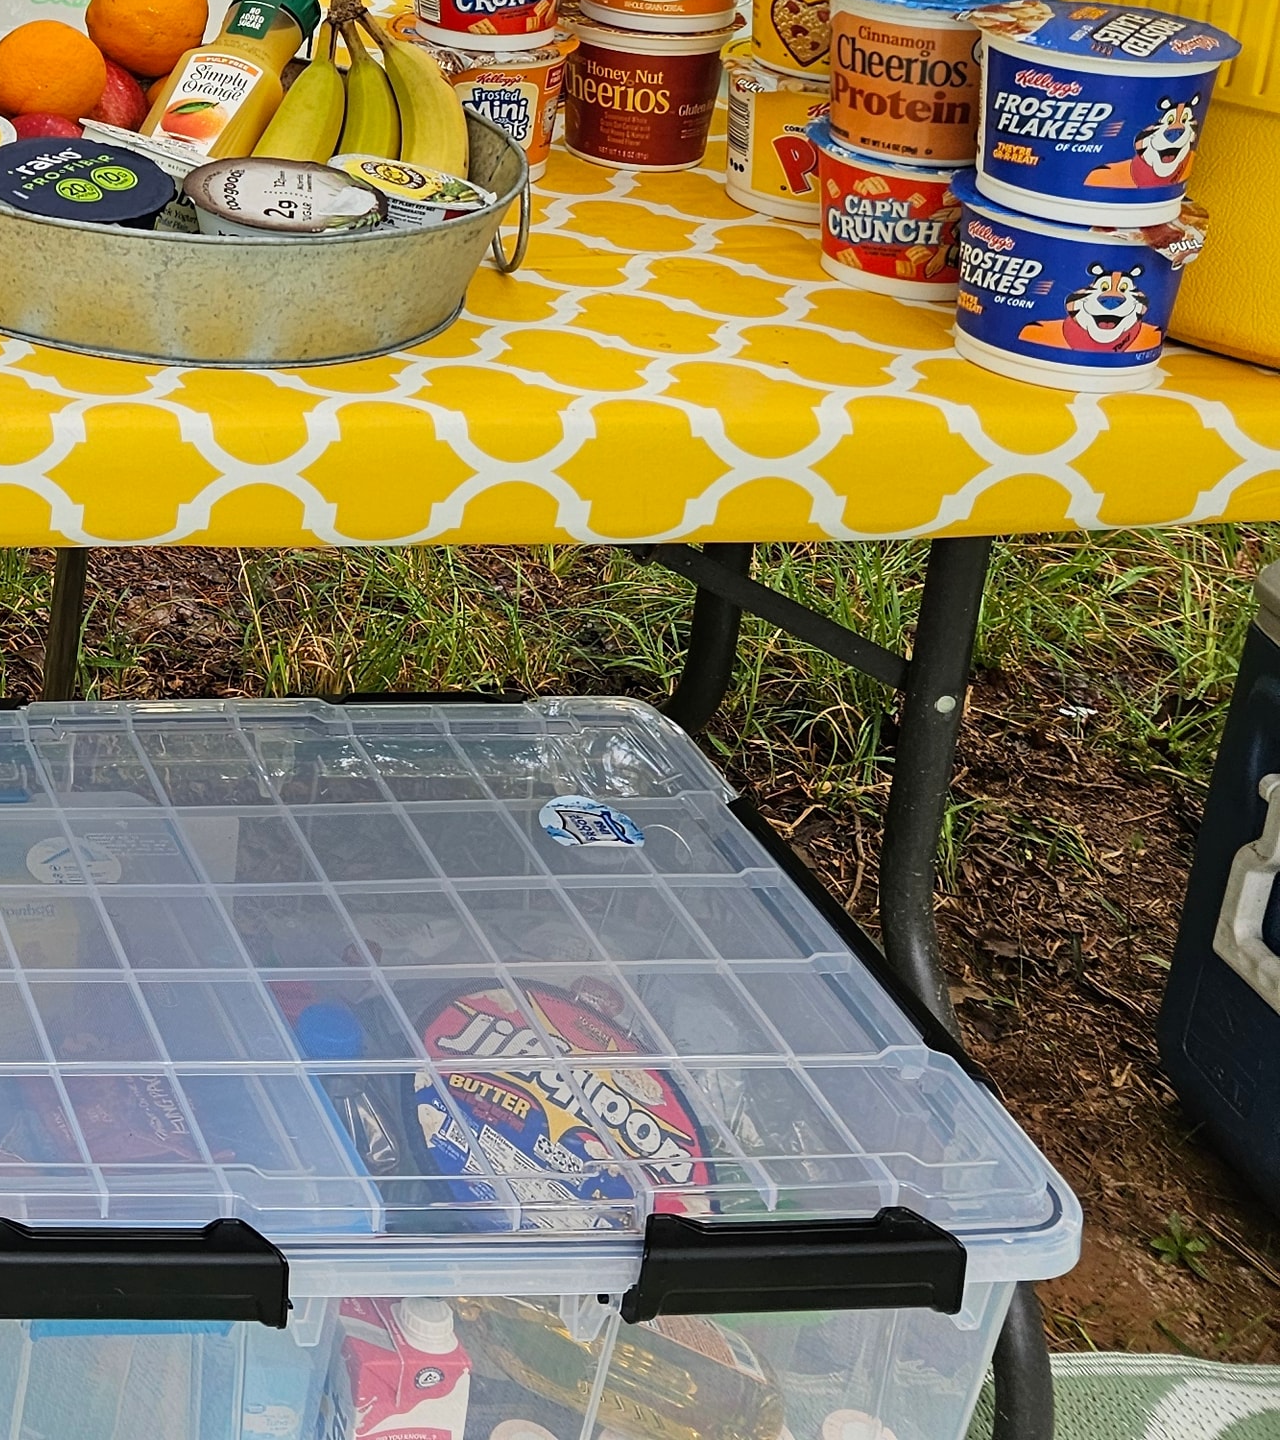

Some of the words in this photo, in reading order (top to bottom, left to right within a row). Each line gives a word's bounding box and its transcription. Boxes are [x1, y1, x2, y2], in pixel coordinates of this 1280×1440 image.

[240, 13, 265, 24] ADDED
[249, 7, 261, 16] NO
[624, 1, 644, 9] WHOLE
[645, 2, 662, 11] GRAIN
[663, 4, 685, 13] CEREAL
[237, 20, 262, 30] SUGAR
[858, 25, 936, 50] Cinnamon
[1092, 12, 1149, 47] FLAKES
[1121, 17, 1187, 57] FROSTED
[206, 56, 227, 65] PULP
[228, 60, 249, 71] FREE
[587, 60, 631, 83] Honey
[635, 70, 664, 85] Nut
[837, 33, 968, 88] Cheerios
[190, 64, 249, 90] Simply
[475, 72, 523, 87] Kellogg's
[565, 60, 670, 115] Cheerios
[1015, 69, 1083, 99] Kellogg's
[182, 80, 246, 101] Orange
[474, 89, 520, 101] Frosted
[833, 71, 971, 125] Protein
[994, 92, 1113, 122] FROSTED
[997, 115, 1099, 142] FLAKES
[881, 140, 891, 150] 1.4
[997, 142, 1032, 157] THEY'RE
[1054, 143, 1071, 153] OF
[1072, 144, 1104, 153] CORN
[263, 199, 298, 221] 2g
[845, 194, 910, 218] CAP'N
[828, 208, 942, 245] CRUNCH
[968, 219, 1016, 252] Kellogg's
[1168, 240, 1203, 253] PULL
[960, 241, 1043, 280] FROSTED
[960, 261, 1030, 296] FLAKES
[994, 295, 1006, 305] OF
[1007, 297, 1035, 310] CORN
[449, 1073, 532, 1120] BUTTER
